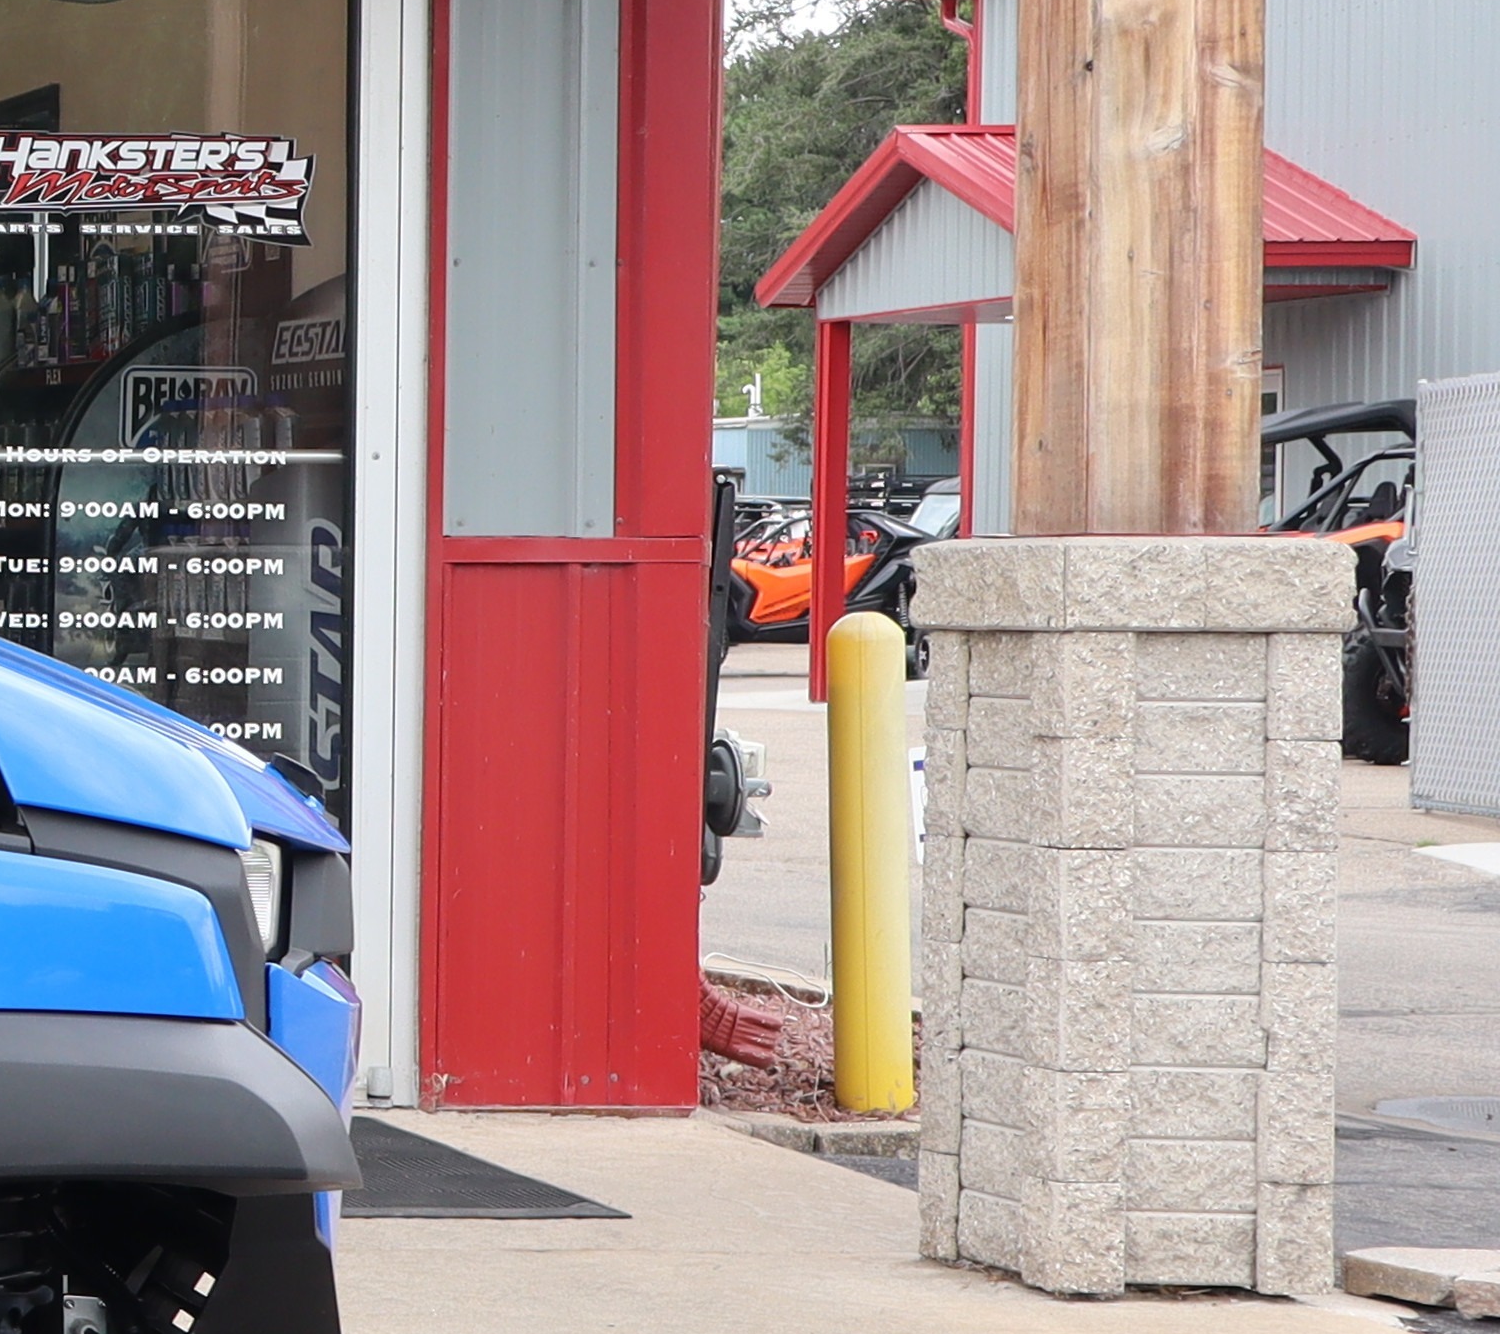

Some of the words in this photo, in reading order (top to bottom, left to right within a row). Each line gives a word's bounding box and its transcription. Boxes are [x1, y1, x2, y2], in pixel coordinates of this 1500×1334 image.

[80, 223, 201, 235] SERVICE
[218, 224, 303, 236] SALES
[308, 369, 343, 387] GENUIN
[6, 446, 92, 463] HOURS
[101, 448, 133, 463] OF
[142, 447, 287, 465] OPERATION
[188, 503, 285, 520] 6:00PM
[59, 556, 158, 574] 9:00AM
[186, 558, 284, 575] 6:00PM
[59, 611, 157, 629] 9:00AM
[186, 612, 283, 629] 6:00PM
[185, 668, 283, 684] 6:00PM
[209, 723, 282, 739] 00PM
